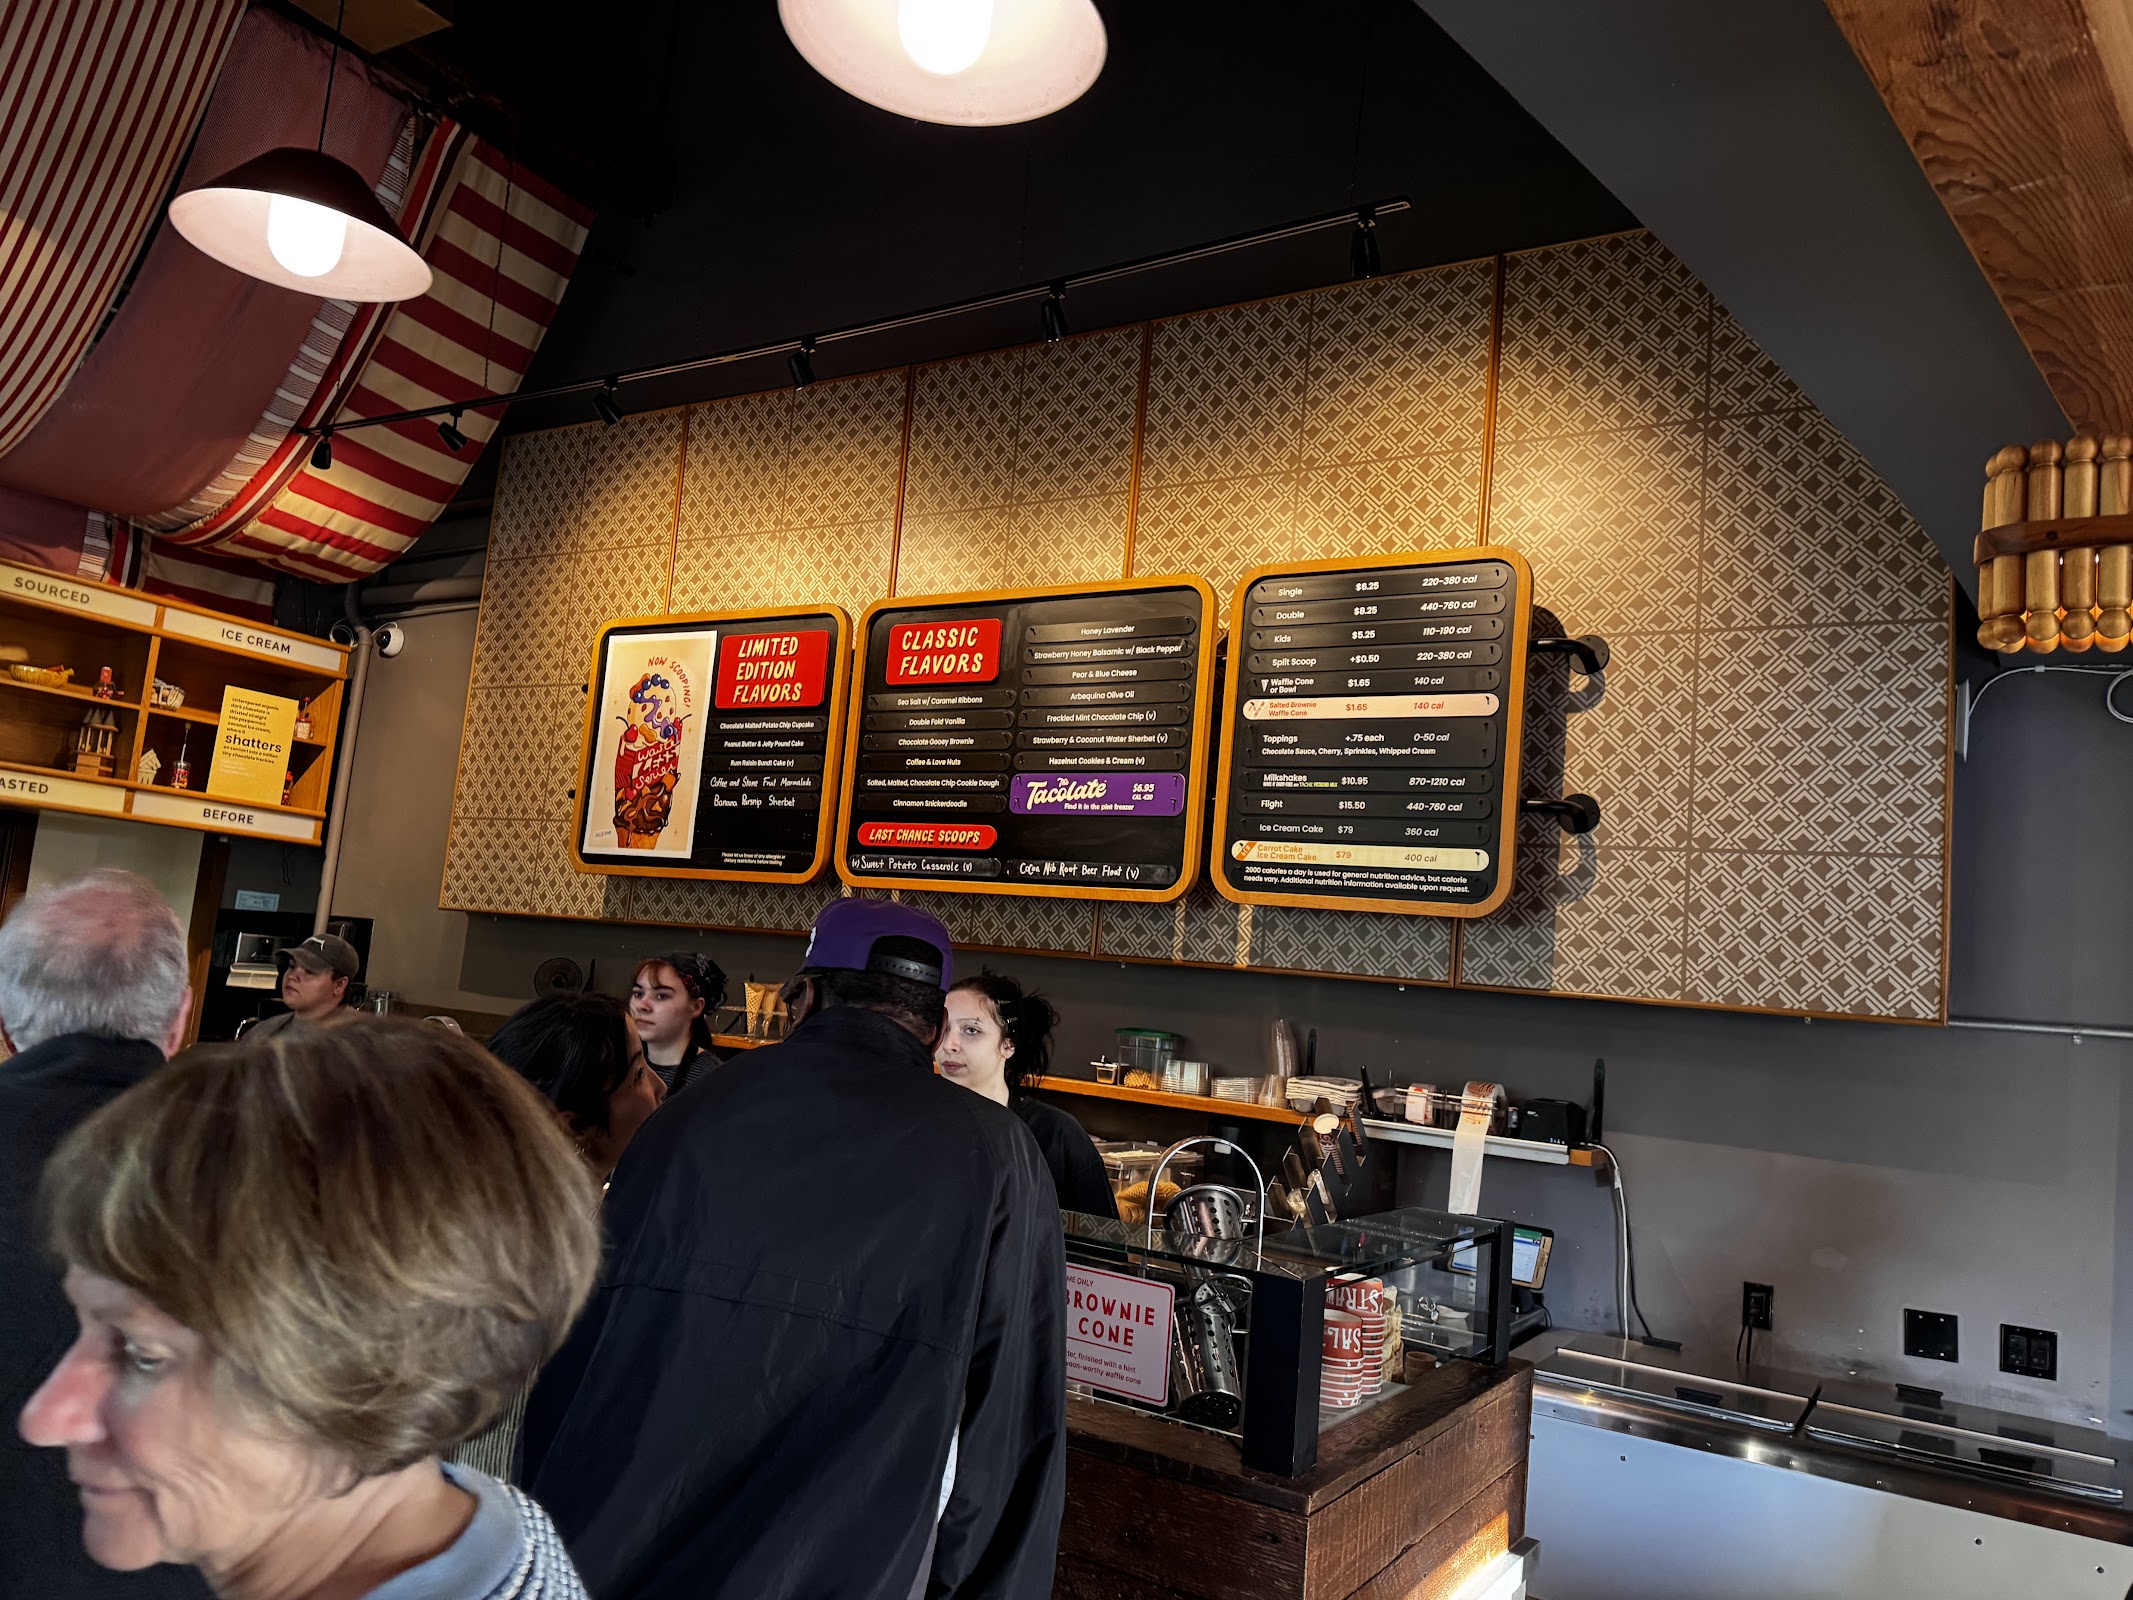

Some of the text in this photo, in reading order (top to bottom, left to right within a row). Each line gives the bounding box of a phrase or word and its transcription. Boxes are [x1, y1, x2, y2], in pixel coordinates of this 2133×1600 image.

[15, 576, 90, 604] SOURCED
[1278, 574, 1478, 597] Single $6.25 220-380 cal
[1276, 600, 1477, 620] Double $8.25 440-760 cal
[1081, 625, 1135, 636] Honey Lavender
[1274, 625, 1472, 643] Kids $5.25 110-190 cal
[222, 627, 291, 655] ICE CREAM
[901, 626, 979, 651] CLASSIC
[738, 636, 798, 658] LIMITED
[1034, 644, 1182, 660] Strawberry Honey Balsamic w/ Black Pepper
[647, 656, 668, 667] NOW
[899, 653, 984, 676] FLAVORS
[1272, 650, 1472, 668] Split Scoop +$0.50 220-380 cal
[735, 660, 796, 680] EDITION
[1271, 676, 1444, 688] Waffle Cone $1.65 140 cal
[1279, 685, 1297, 694] Bowl
[732, 682, 802, 704] FLAVORS
[1070, 690, 1135, 701] Arbequina Olive Oil
[1269, 700, 1444, 712] Salted Brownie $1.65 140 cal
[1269, 709, 1289, 717] Waffle
[1047, 710, 1157, 722] Freckled Mint Chocolate Chip (v)
[720, 722, 745, 730] Chocolate
[762, 721, 779, 729] Potato
[779, 721, 791, 730] Chip
[791, 720, 815, 730] Cupcake
[225, 734, 282, 753] shatters
[898, 737, 974, 747] Chocolate Gooey Brownie
[1263, 733, 1450, 744] Toppings +.75 each 0-50 cal
[1262, 747, 1436, 757] Chocolate Sauce, Cherry, Sprinkles, Whipped Cream
[866, 779, 999, 789] Salted, Malted, Chocolate Chip Cookie Dough
[1263, 773, 1308, 782] Milkshakes
[1341, 776, 1369, 786] $10.95
[1409, 777, 1449, 787] 870-1210
[1450, 777, 1465, 787] cal
[1026, 778, 1107, 811] Tacolate
[1132, 783, 1155, 793] $6.95
[768, 795, 795, 807] Sherbet
[925, 800, 968, 808] Snickerdoodle
[1261, 800, 1463, 812] Flight $15.50 440-760 cal
[203, 808, 255, 825] BEFORE
[869, 828, 981, 843] LAST CHANCE SCOOPS
[1260, 824, 1439, 837] Ice Cream Cake $79 360 cal
[1257, 844, 1281, 852] Carrot
[1284, 845, 1303, 853] Cake
[888, 857, 917, 870] Potato
[921, 858, 959, 872] Casserole
[1270, 852, 1295, 860] Cream
[1297, 853, 1317, 861] Cake
[1335, 851, 1352, 859] $79
[1404, 854, 1422, 862] 400
[1424, 854, 1437, 863] cal
[1059, 862, 1078, 877] Root
[1102, 865, 1122, 877] Float
[1264, 876, 1280, 885] vary.
[1280, 877, 1314, 885] Additional
[1314, 878, 1343, 886] nutrition
[1344, 879, 1384, 888] information
[1385, 881, 1418, 890] available
[1419, 884, 1438, 892] upon
[1440, 884, 1470, 894] request.
[1077, 1277, 1094, 1287] ONLY
[1078, 1317, 1134, 1347] CONE
[1323, 1327, 1362, 1353] SAL
[1078, 1352, 1103, 1364] finished
[1103, 1360, 1117, 1369] with
[1123, 1364, 1136, 1373] hint
[1105, 1369, 1125, 1380] waffle
[1126, 1376, 1142, 1385] cone
